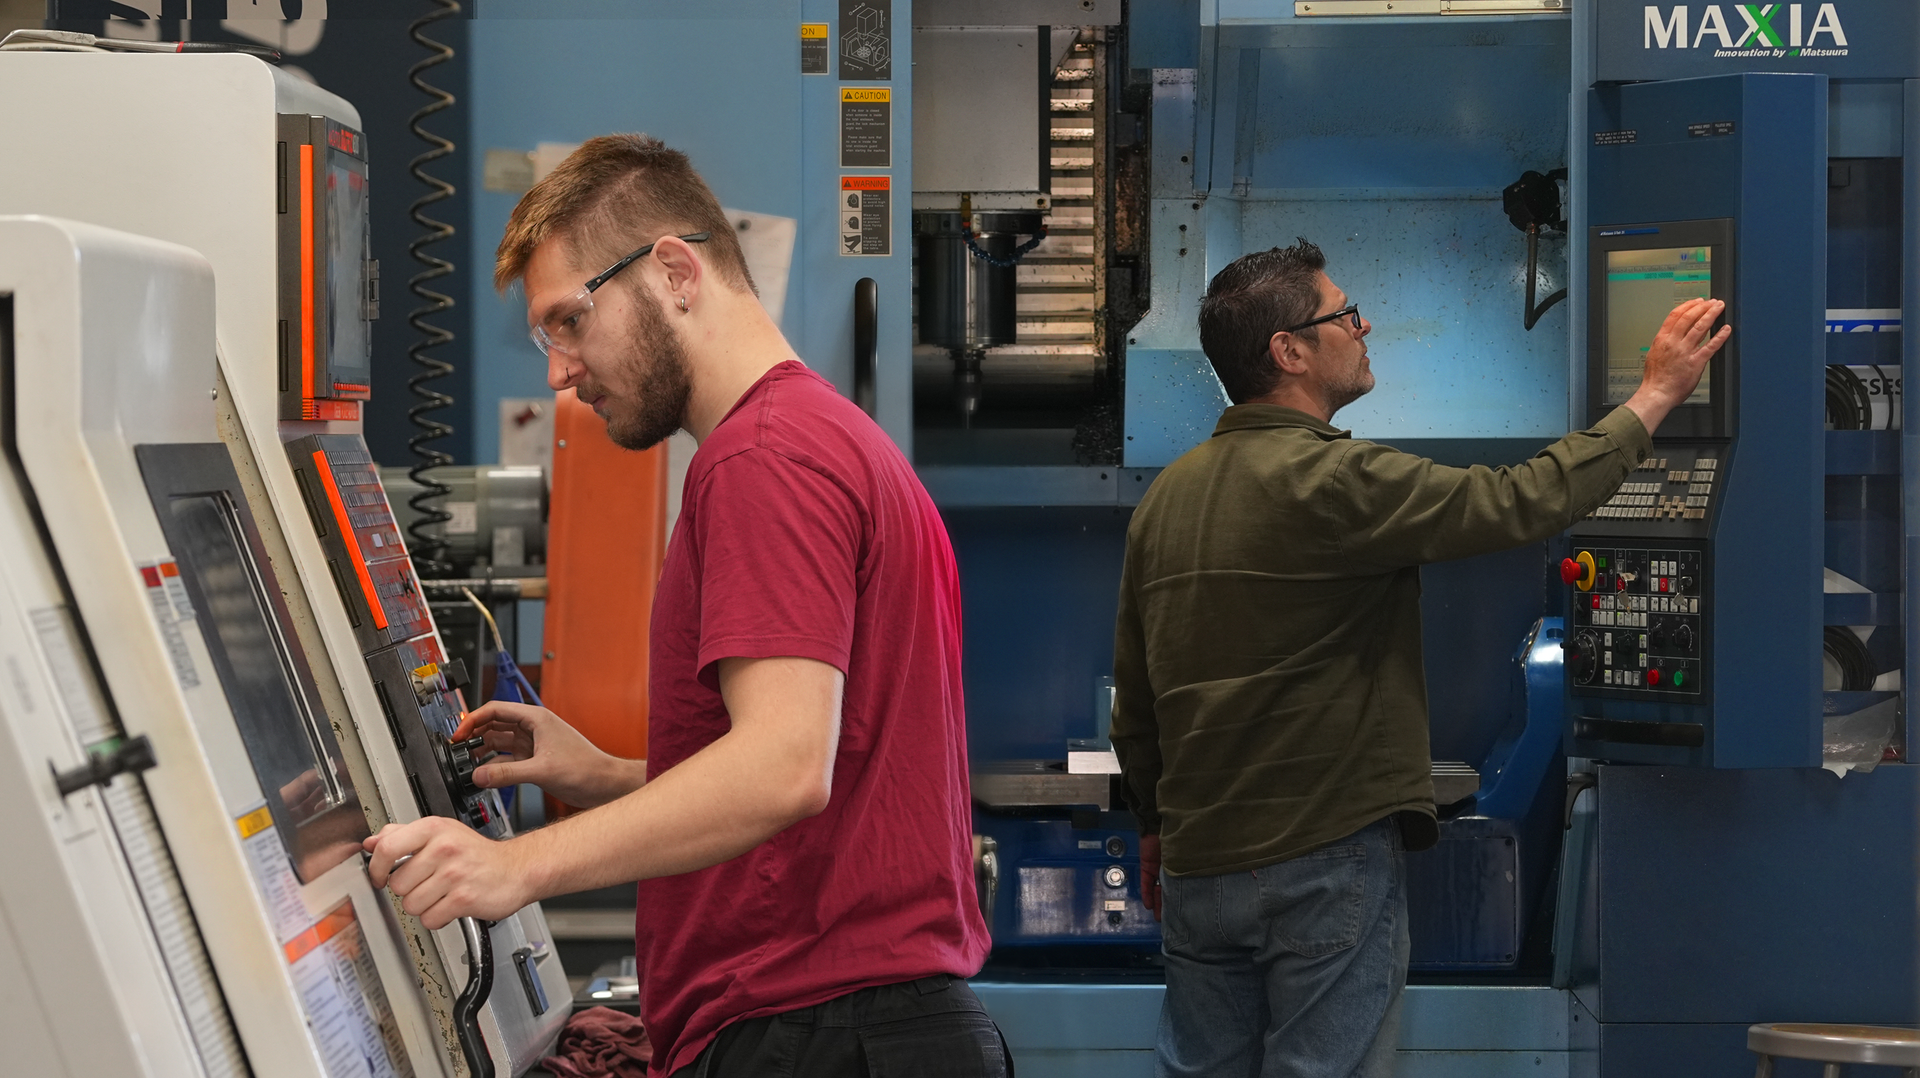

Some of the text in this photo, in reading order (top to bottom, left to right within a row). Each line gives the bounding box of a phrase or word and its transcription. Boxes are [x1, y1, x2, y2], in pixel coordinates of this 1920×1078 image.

[1714, 48, 1848, 58] Innovation by Matsuura
[854, 91, 886, 99] CAUTION
